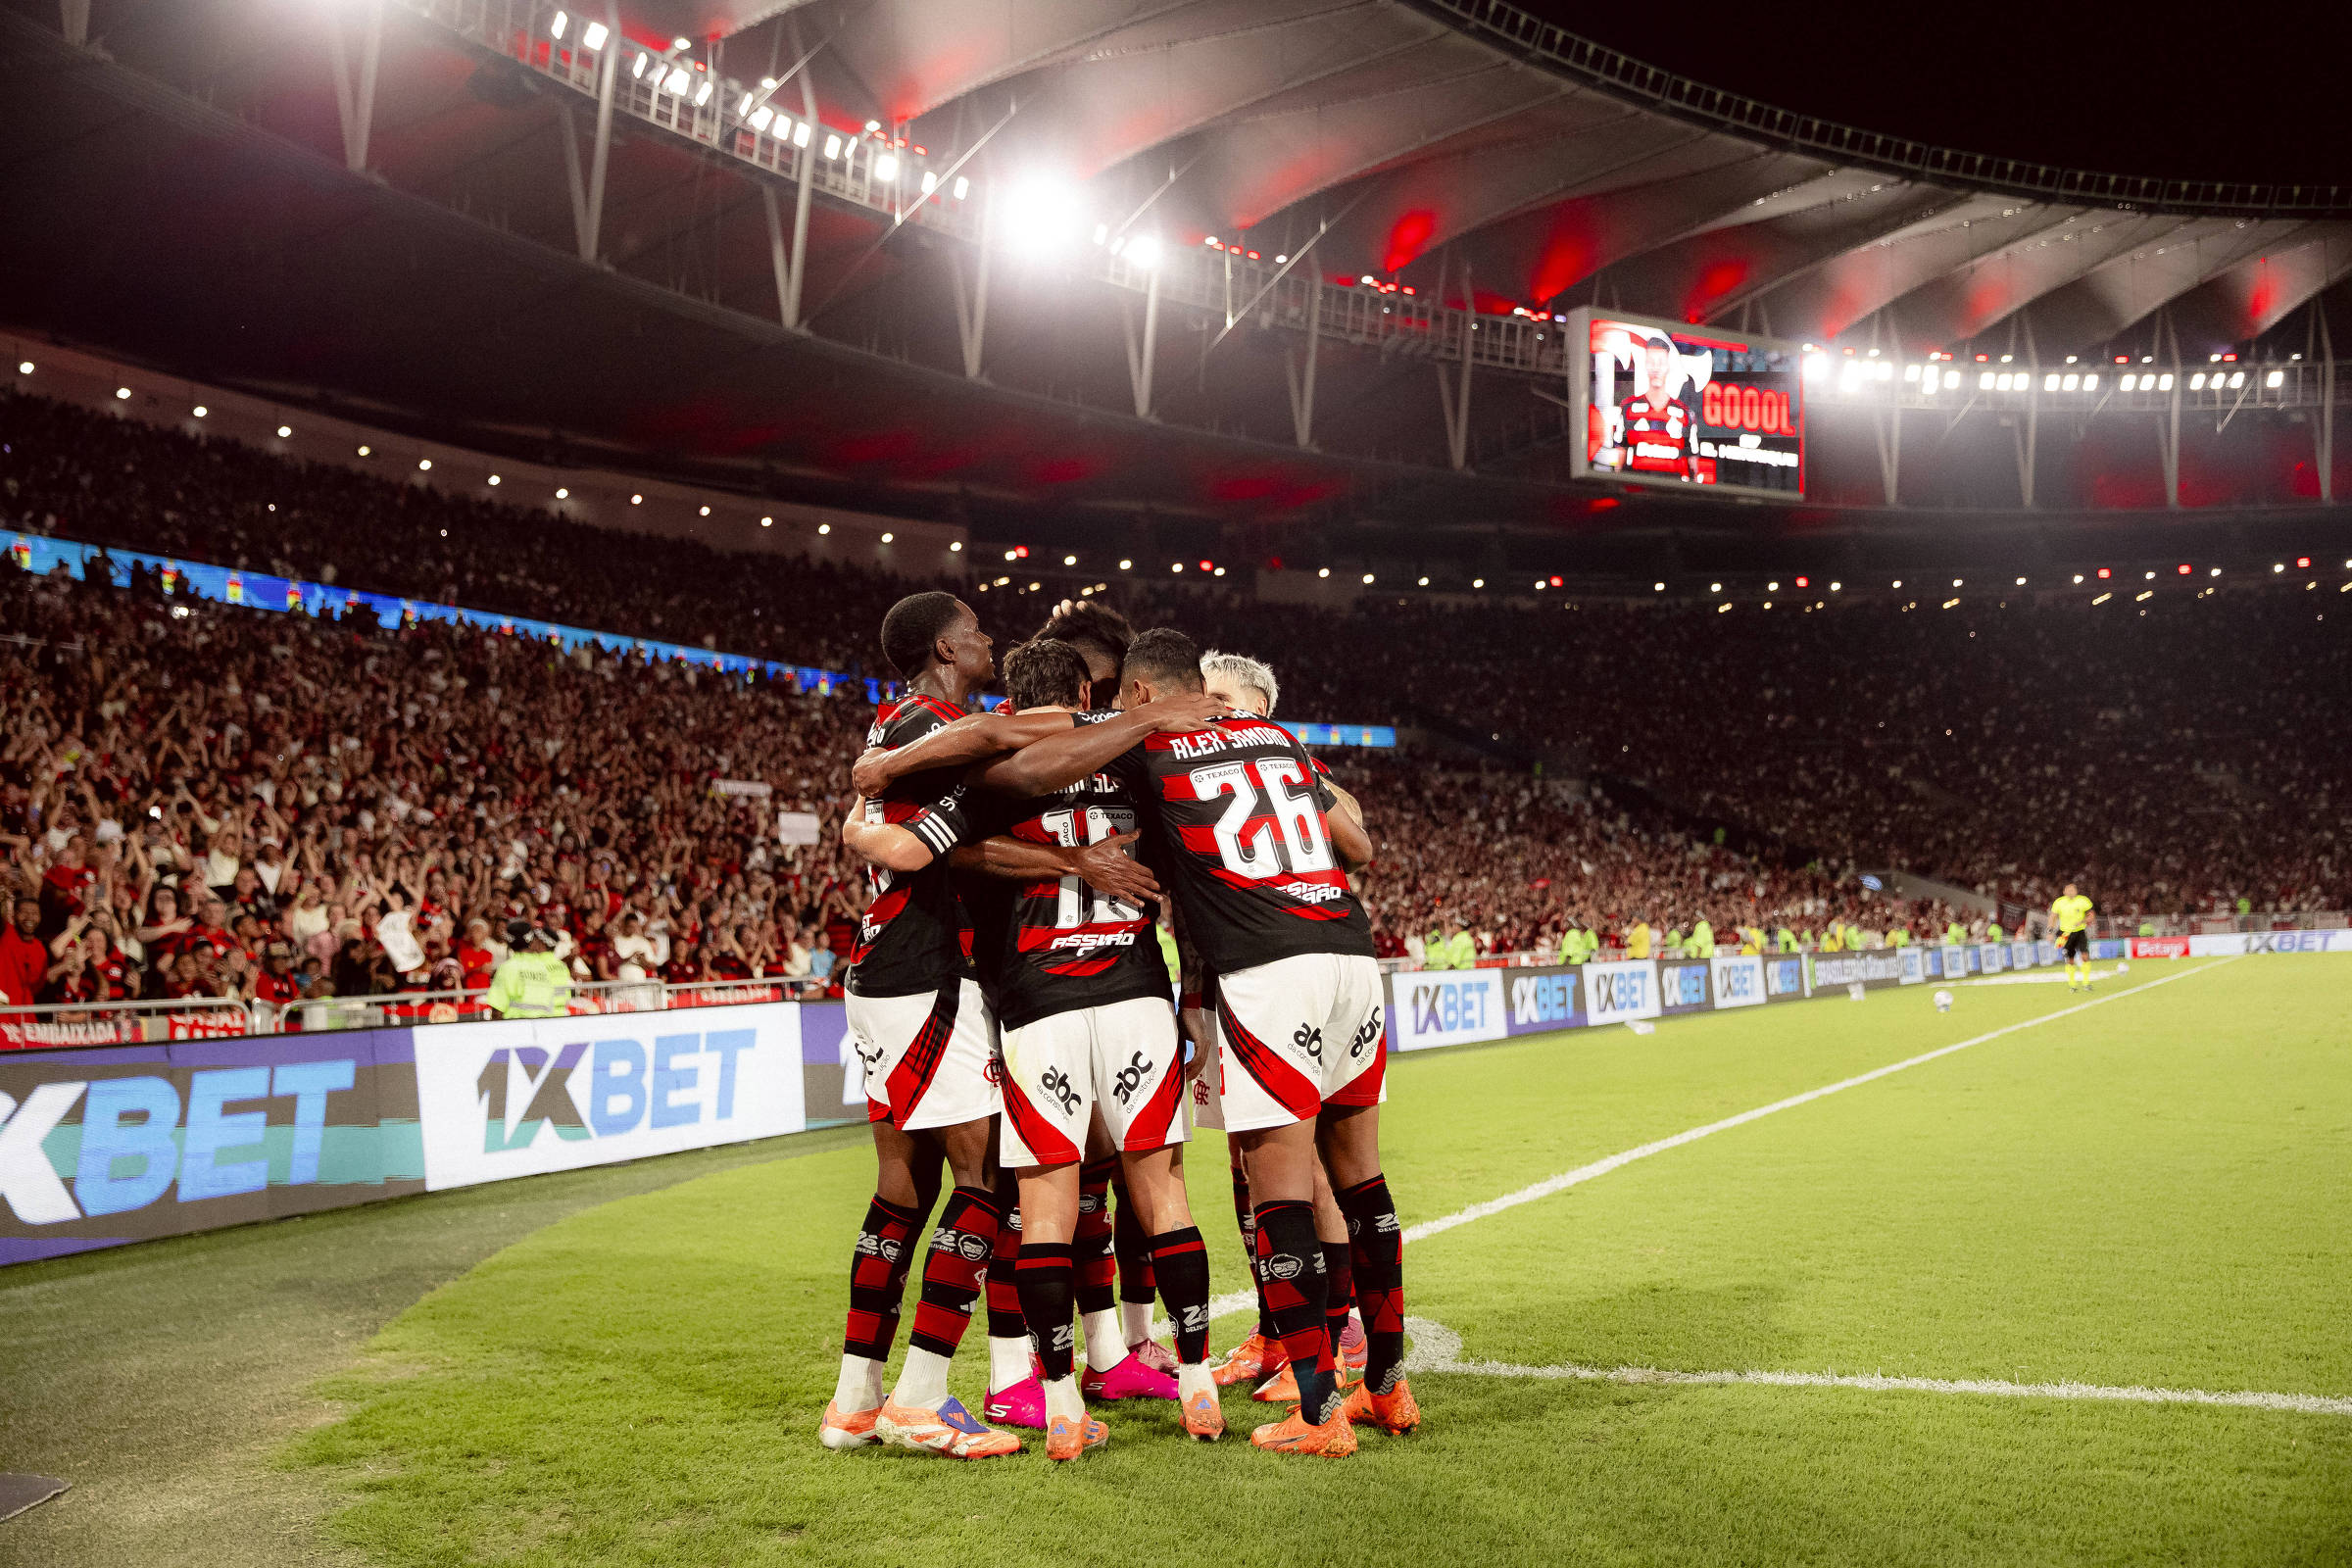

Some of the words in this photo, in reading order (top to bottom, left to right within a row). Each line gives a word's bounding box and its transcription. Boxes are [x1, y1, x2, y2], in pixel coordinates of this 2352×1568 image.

[1702, 380, 1796, 437] GOOOL
[1169, 731, 1226, 760] ALEX
[1226, 726, 1291, 749] SANDRO
[1205, 767, 1240, 780] TEXACO
[1061, 821, 1070, 847] XACO
[1190, 757, 1333, 880] 26
[2244, 930, 2336, 955] 1XBET
[1411, 981, 1490, 1035] 1XBET
[1512, 974, 1577, 1025] 1XBET
[1596, 970, 1647, 1012] 1XBET
[1294, 1022, 1323, 1067] ab
[477, 1028, 758, 1154] 1XBET
[1041, 1064, 1082, 1117] abc
[1112, 1050, 1153, 1106] abc
[0, 1059, 356, 1225] XBET
